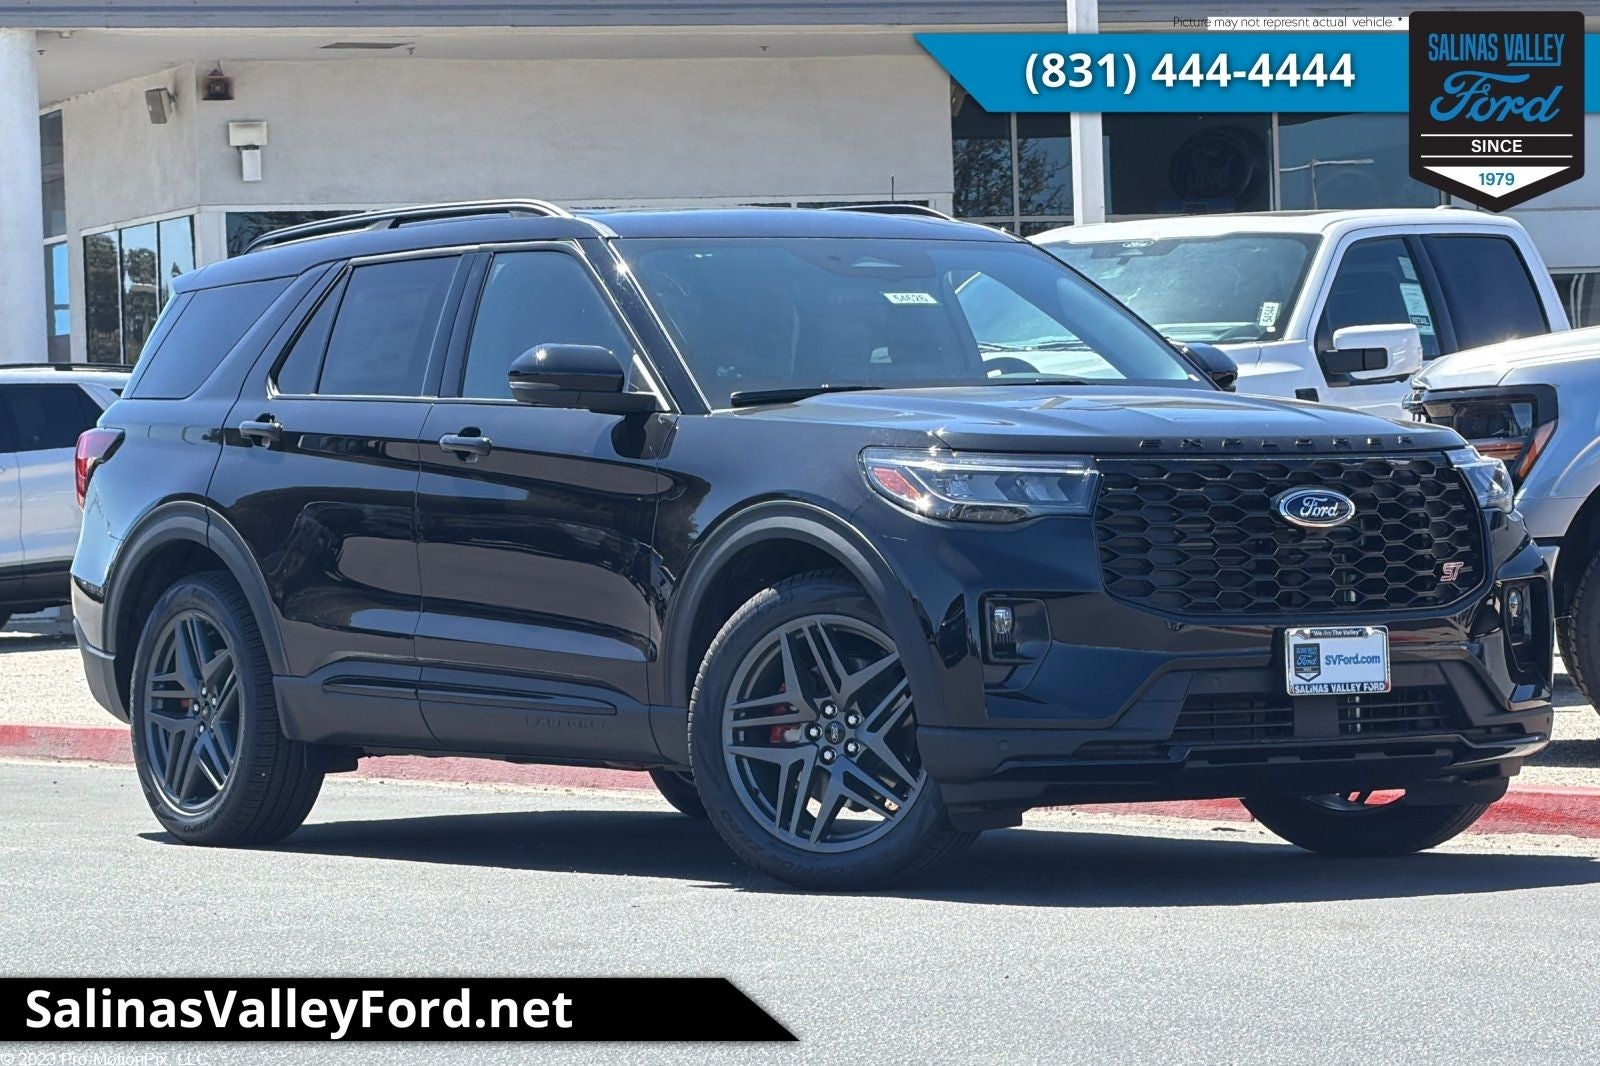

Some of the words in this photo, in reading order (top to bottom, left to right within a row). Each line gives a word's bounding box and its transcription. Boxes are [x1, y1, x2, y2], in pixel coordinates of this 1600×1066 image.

[1300, 496, 1339, 518] Ford
[1440, 562, 1464, 581] ST
[1325, 653, 1380, 665] SVFord.com
[1295, 684, 1329, 694] SALINAS
[1331, 683, 1361, 693] VALLEY
[1364, 682, 1385, 692] FORD
